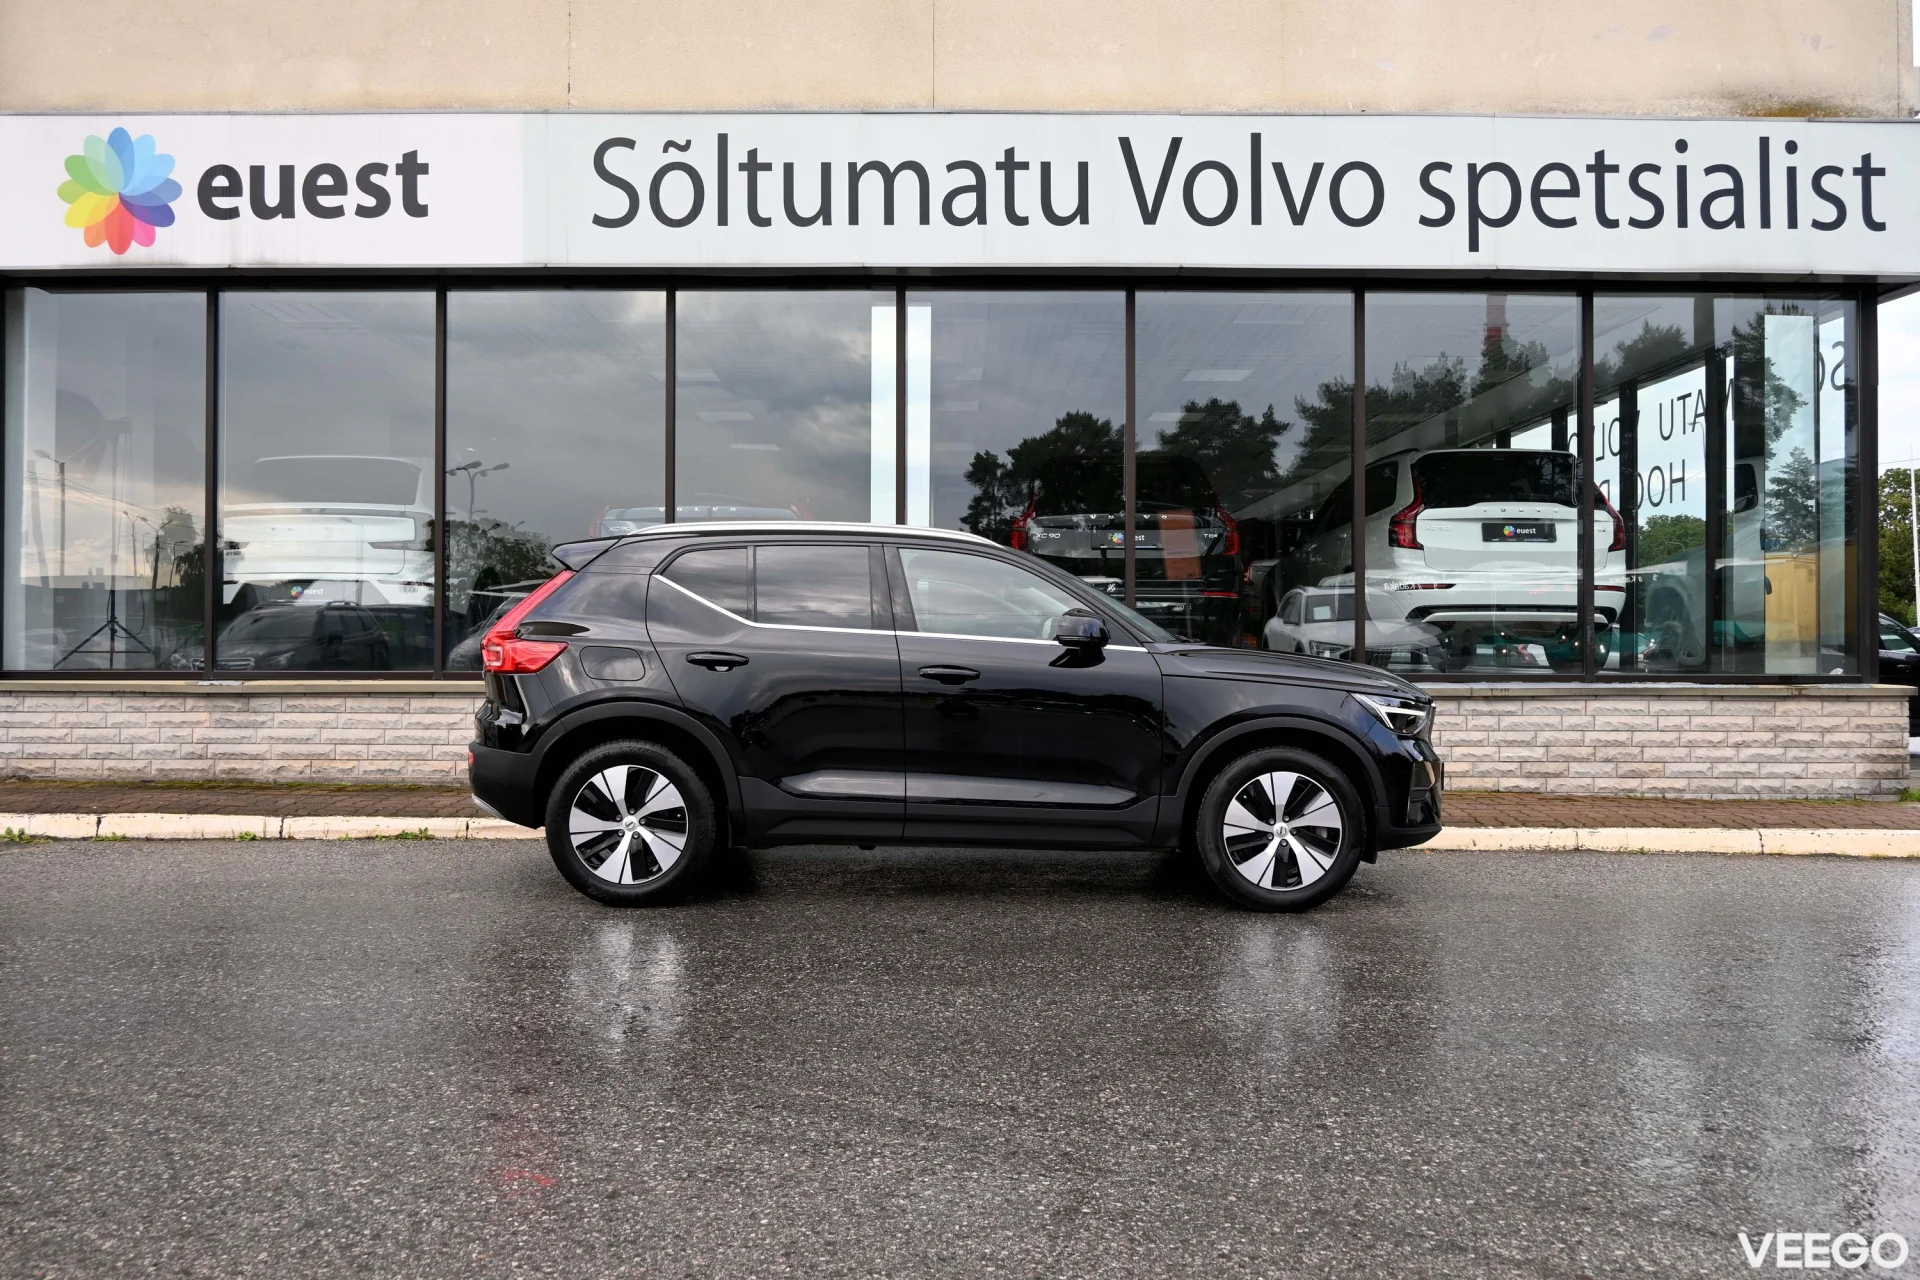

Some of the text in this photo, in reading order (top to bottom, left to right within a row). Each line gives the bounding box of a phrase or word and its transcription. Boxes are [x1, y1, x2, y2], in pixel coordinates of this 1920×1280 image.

[197, 150, 430, 220] euest
[592, 132, 1887, 253] Sõltumatu Volvo spetsialist
[1516, 527, 1536, 535] euest
